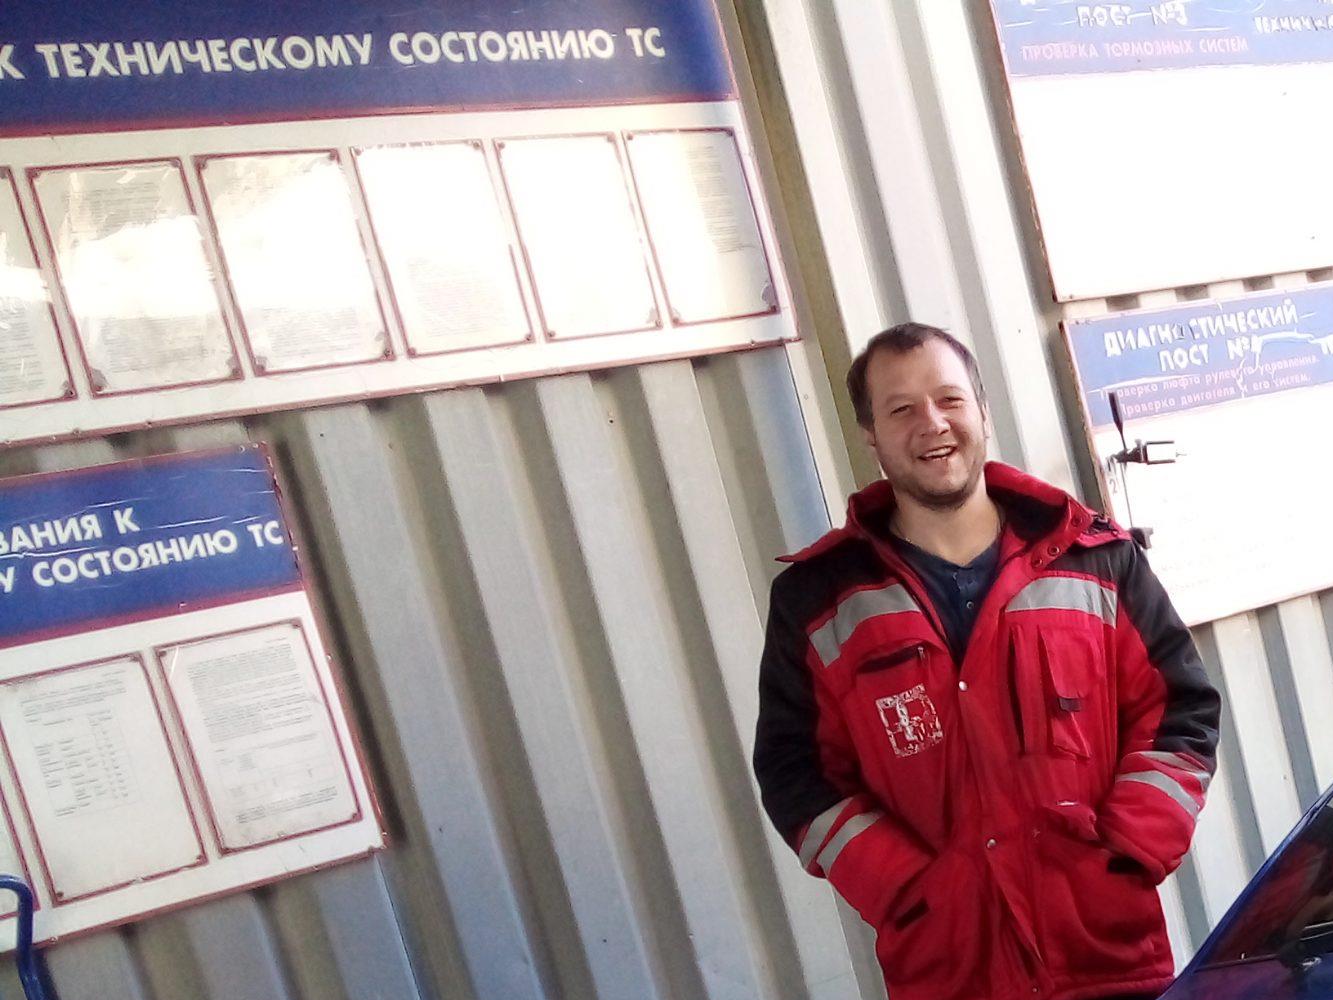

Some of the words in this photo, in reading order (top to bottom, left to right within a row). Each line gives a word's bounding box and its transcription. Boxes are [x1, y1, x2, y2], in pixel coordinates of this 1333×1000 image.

[34, 32, 374, 79] ТЕХНИЧЕСКОМУ
[388, 28, 615, 66] СОСТОЯНИЮ
[626, 27, 665, 59] ТС
[1021, 42, 1098, 61] ПРОВЕРКА
[1103, 38, 1194, 59] ТОРМОЗНЫХ
[1199, 35, 1249, 53] СИСТЕМ
[1158, 343, 1209, 372] ПОСТ
[112, 507, 141, 535] К
[32, 529, 238, 588] СОСТОЯНИЮ
[248, 520, 284, 549] ТС
